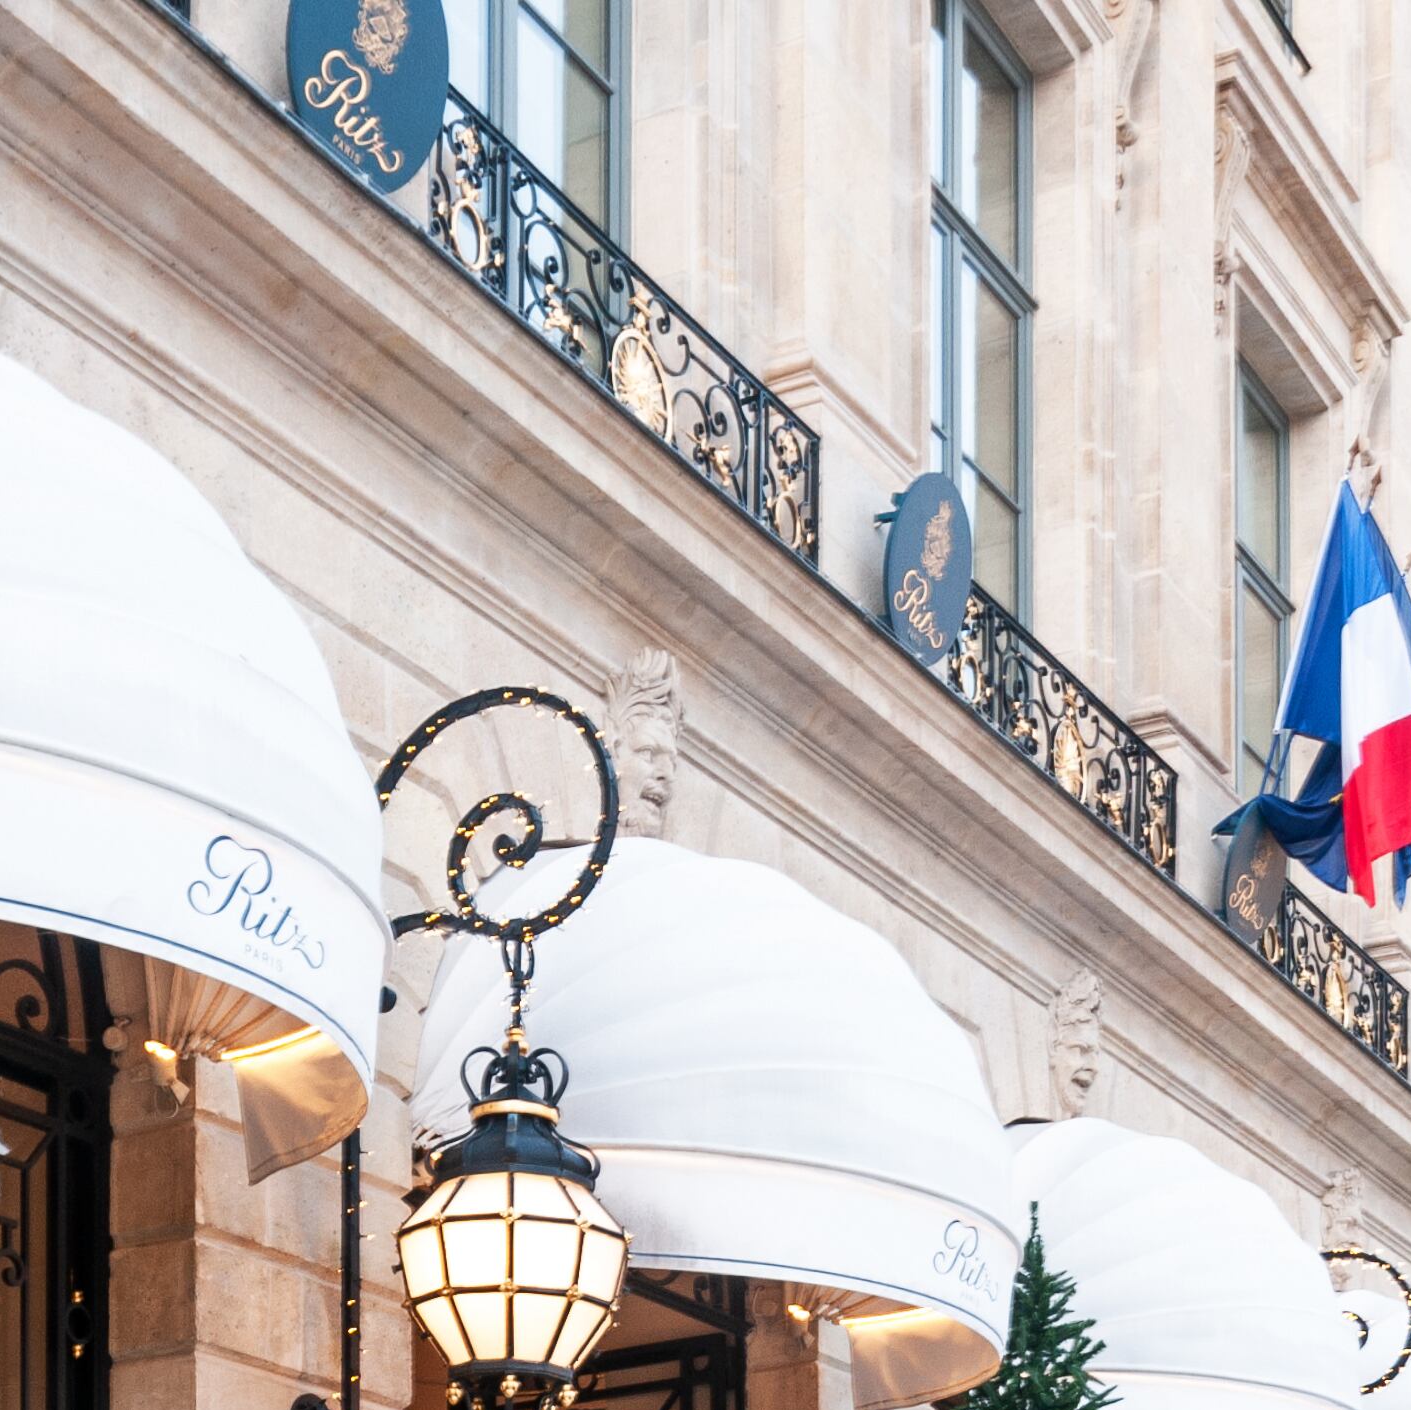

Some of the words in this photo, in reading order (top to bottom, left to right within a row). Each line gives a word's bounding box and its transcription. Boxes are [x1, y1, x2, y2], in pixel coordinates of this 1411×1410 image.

[304, 49, 403, 172] Ritz
[333, 134, 361, 165] PARIS
[893, 569, 944, 649] Ritz
[187, 835, 325, 969] Ritz
[1229, 873, 1264, 930] Ritz
[932, 1219, 999, 1302] Ritz
